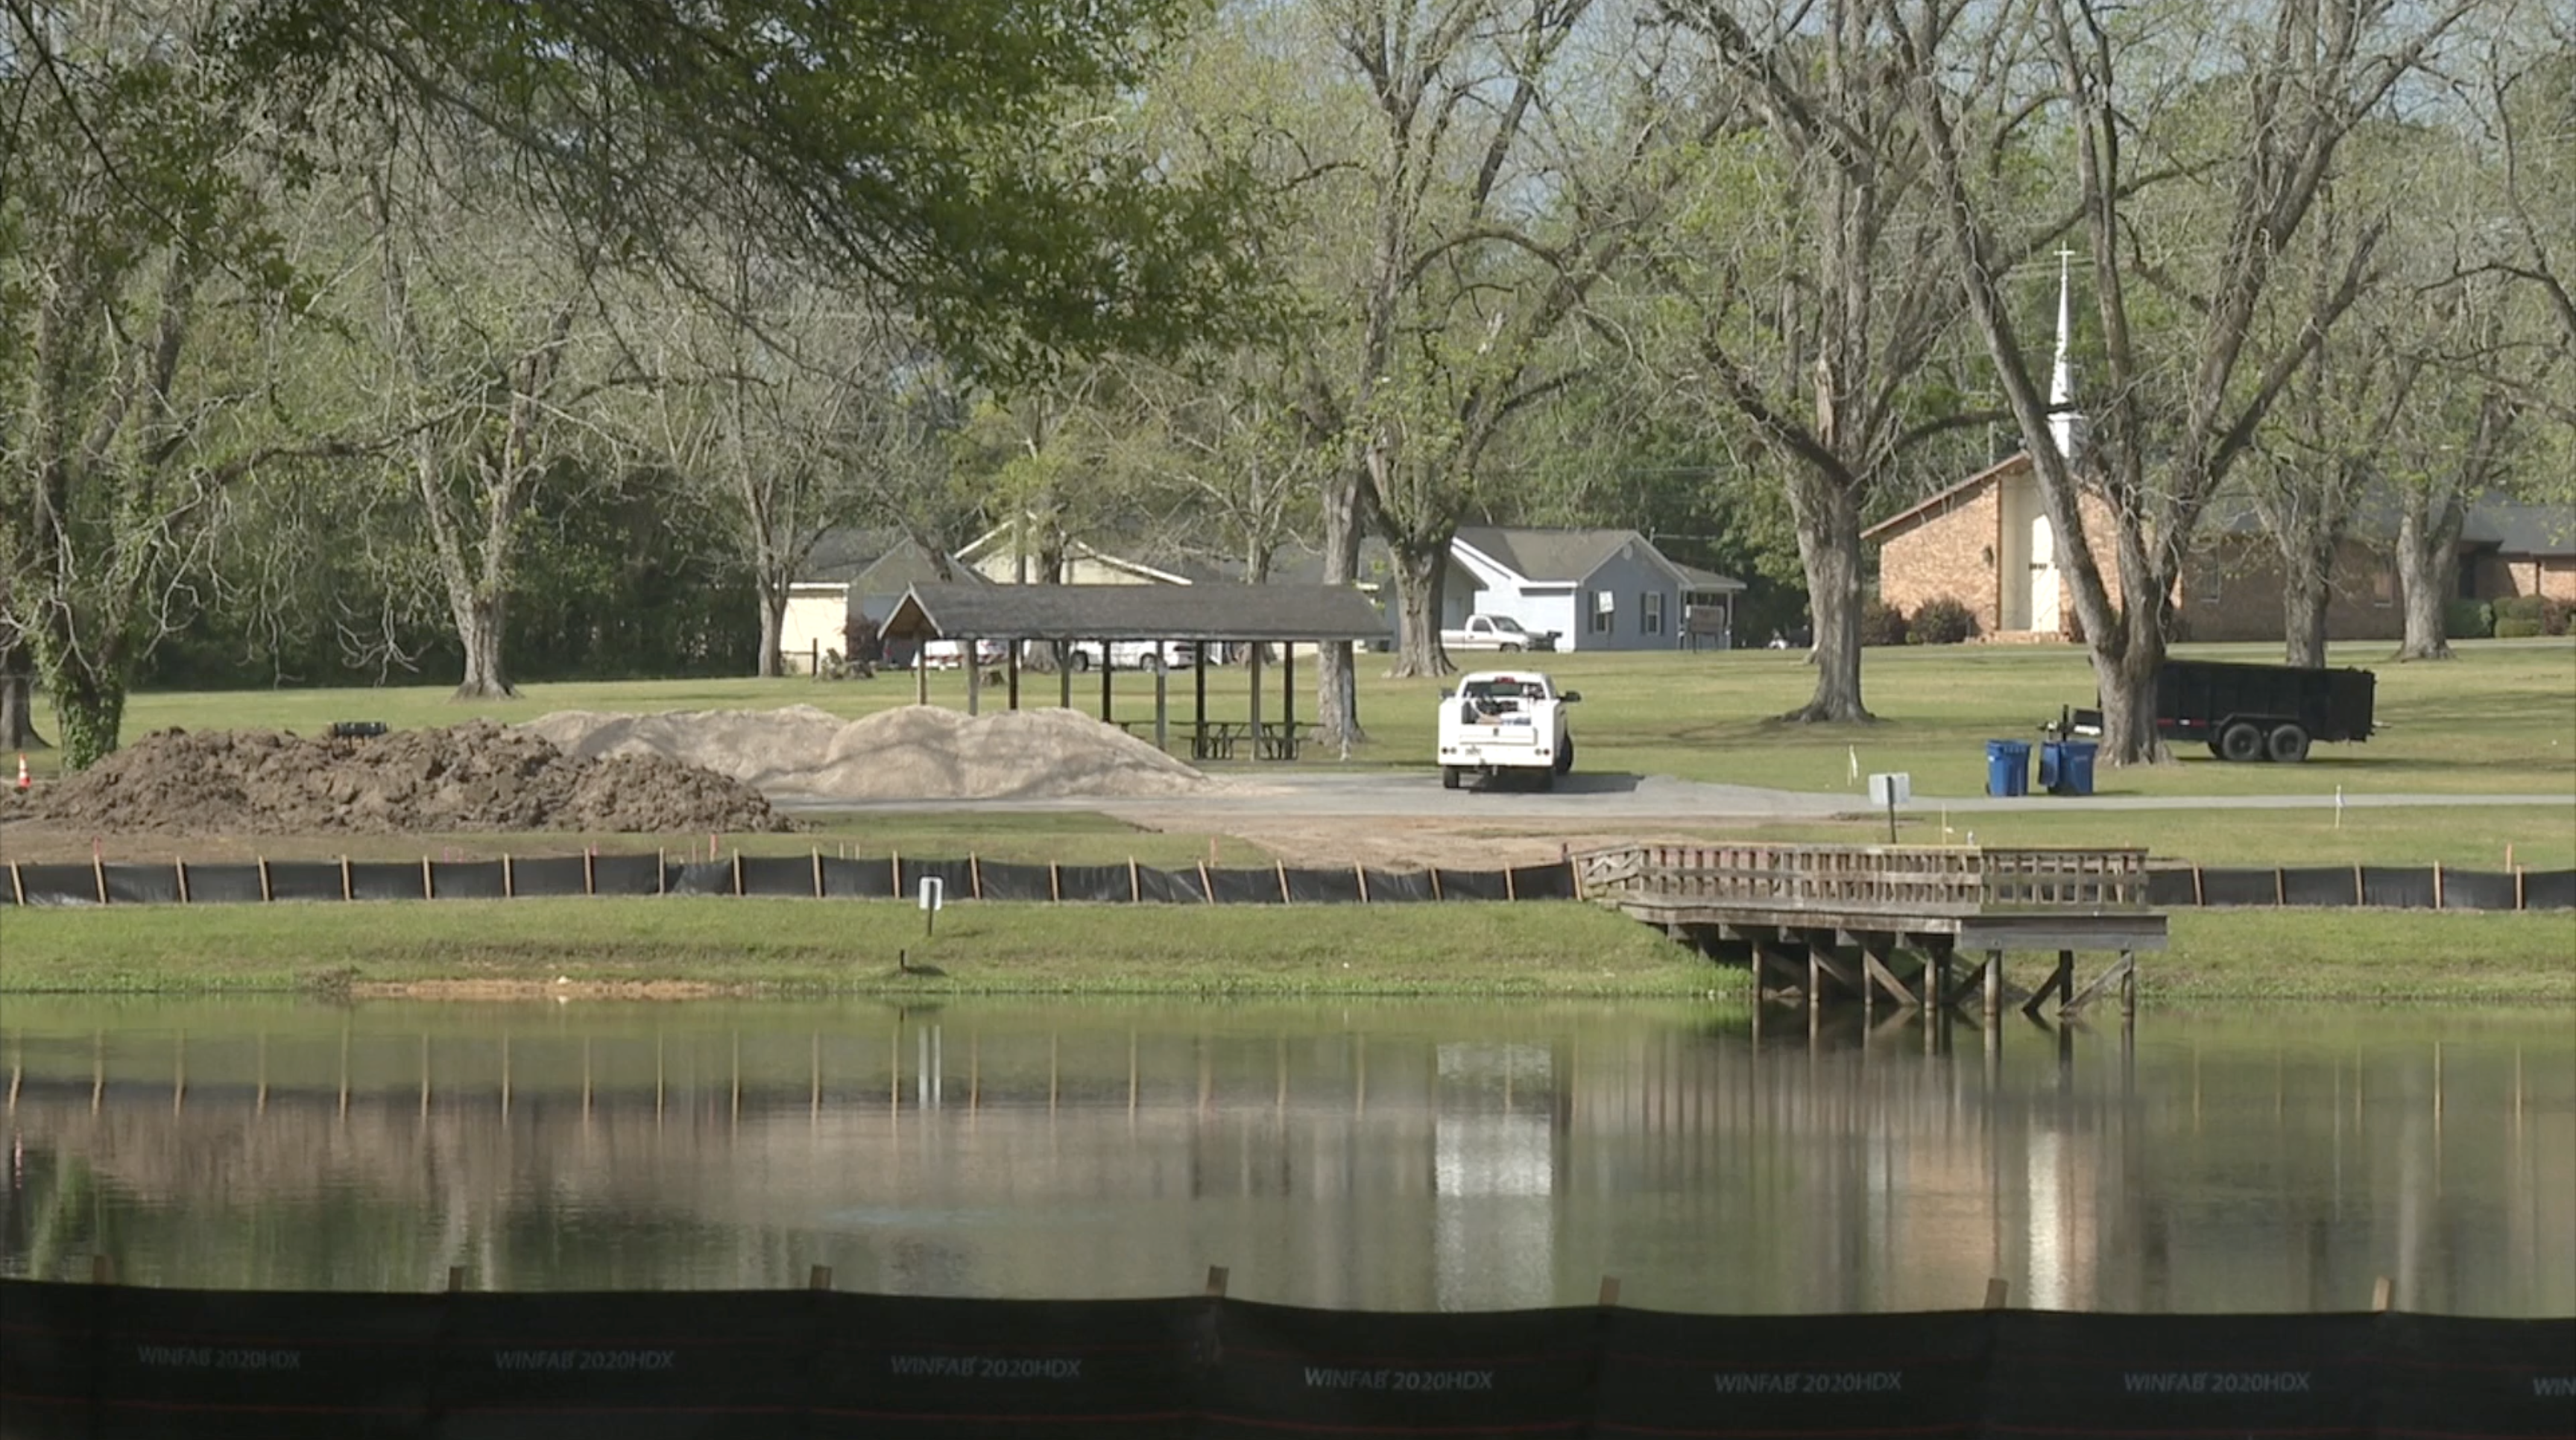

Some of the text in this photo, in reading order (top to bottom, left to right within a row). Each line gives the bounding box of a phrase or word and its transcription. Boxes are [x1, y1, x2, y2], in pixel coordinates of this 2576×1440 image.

[578, 1351, 676, 1369] 2020HDX
[980, 1359, 1082, 1377] 2020HDX
[1304, 1366, 1493, 1390] WINFAB 2020HDX
[1714, 1371, 1902, 1393] WINFAB 2020HDX
[2125, 1372, 2311, 1392] WINFAB 2020HDX
